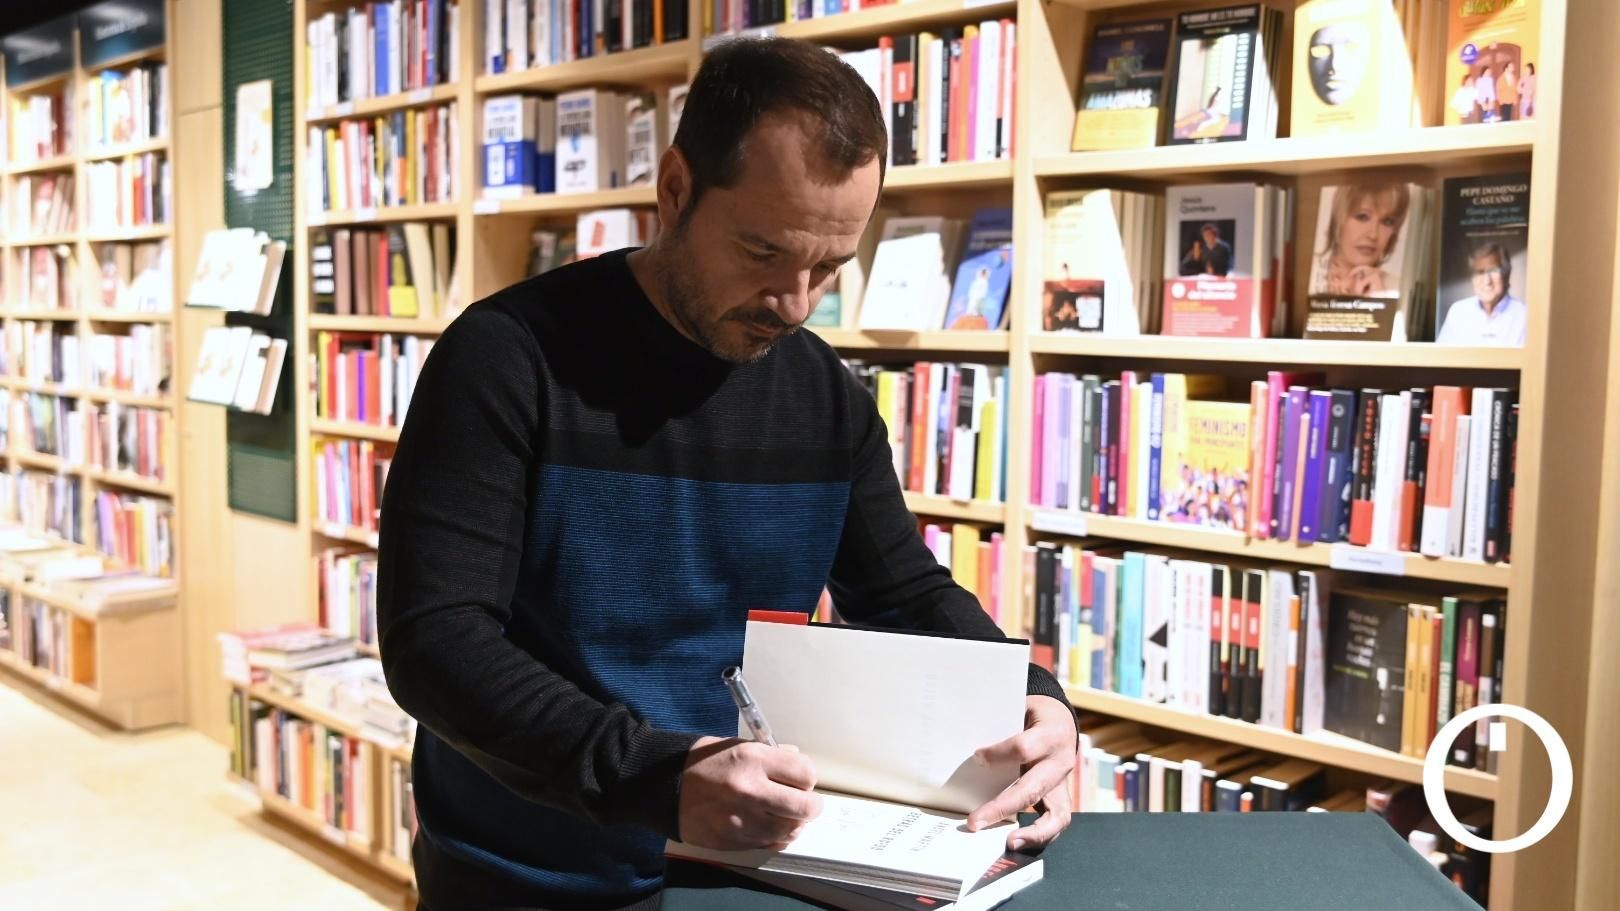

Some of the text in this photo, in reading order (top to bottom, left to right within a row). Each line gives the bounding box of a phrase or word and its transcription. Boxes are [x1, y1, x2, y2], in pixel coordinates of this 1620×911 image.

[1460, 183, 1528, 198] PEPE DOMINGO
[1190, 417, 1247, 438] FEMINISMO
